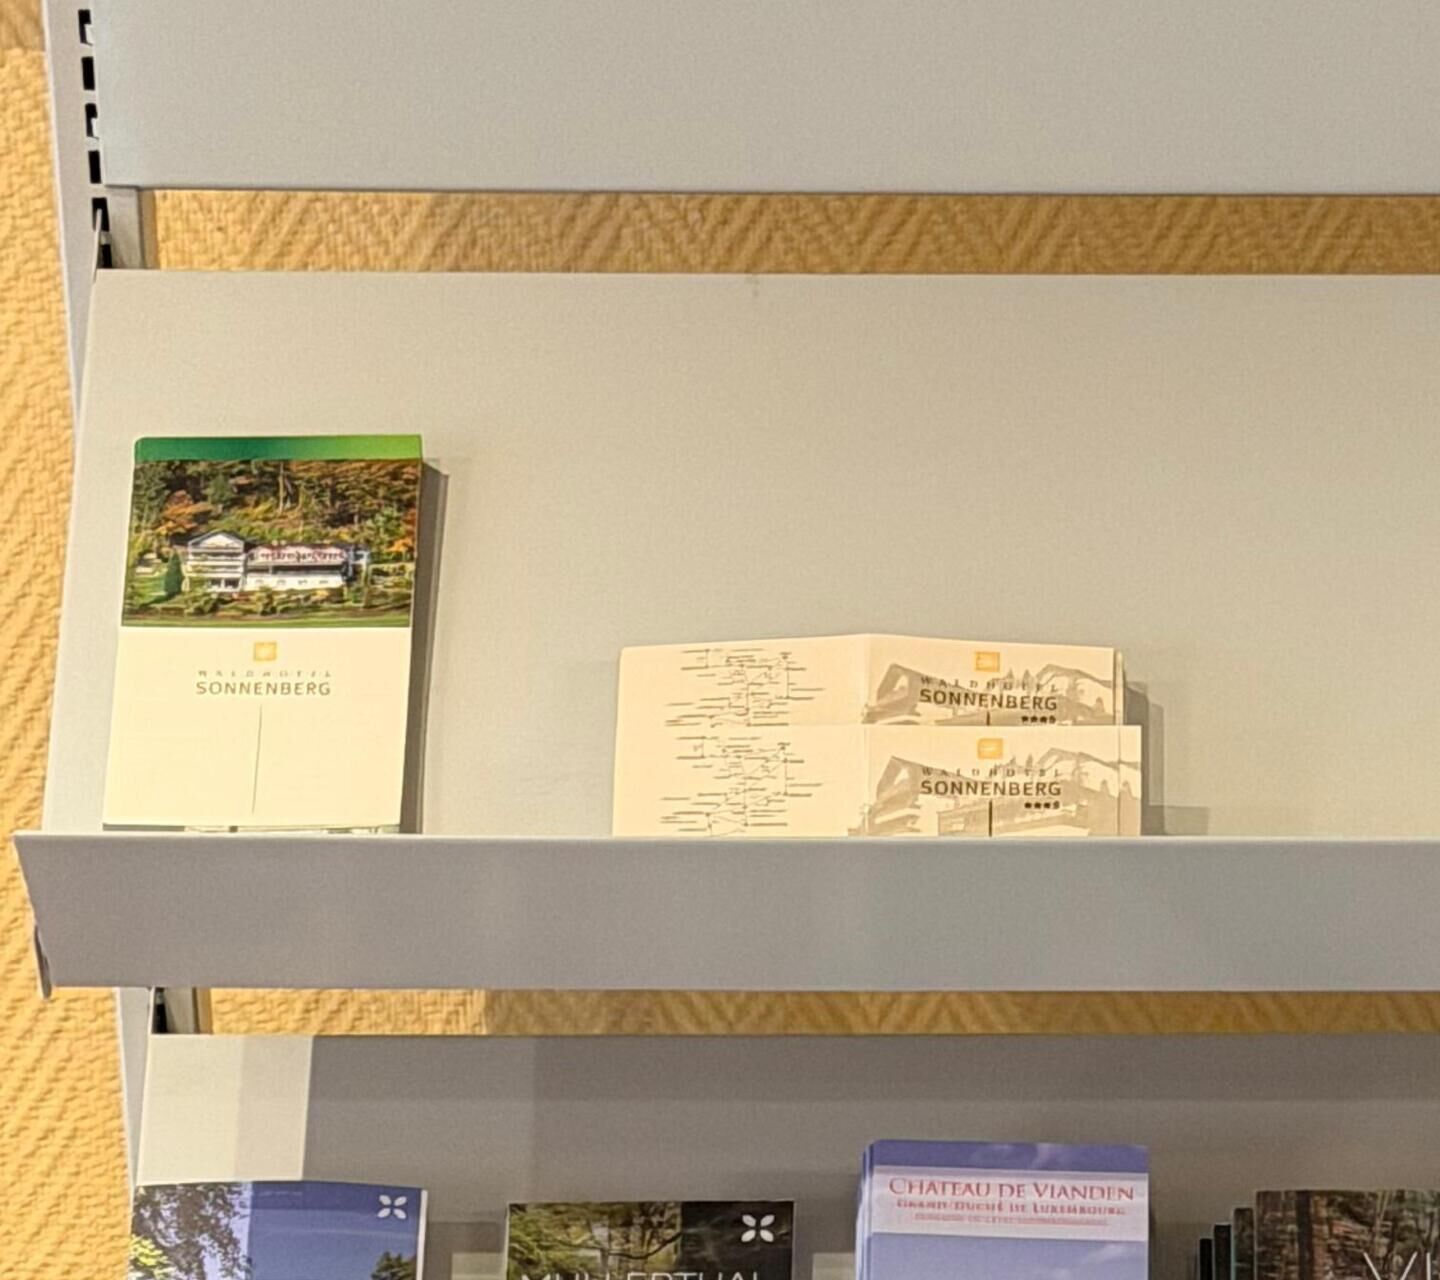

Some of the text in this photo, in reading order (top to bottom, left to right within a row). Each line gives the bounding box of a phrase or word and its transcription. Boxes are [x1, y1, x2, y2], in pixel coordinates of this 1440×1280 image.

[197, 669, 332, 678] WALDHOTEL
[195, 681, 332, 696] SONNENBERG
[919, 689, 1059, 711] SONNENBERG
[920, 780, 1062, 797] SONNENBERG
[999, 1182, 1026, 1199] DE
[1032, 1181, 1135, 1201] VIANDEN
